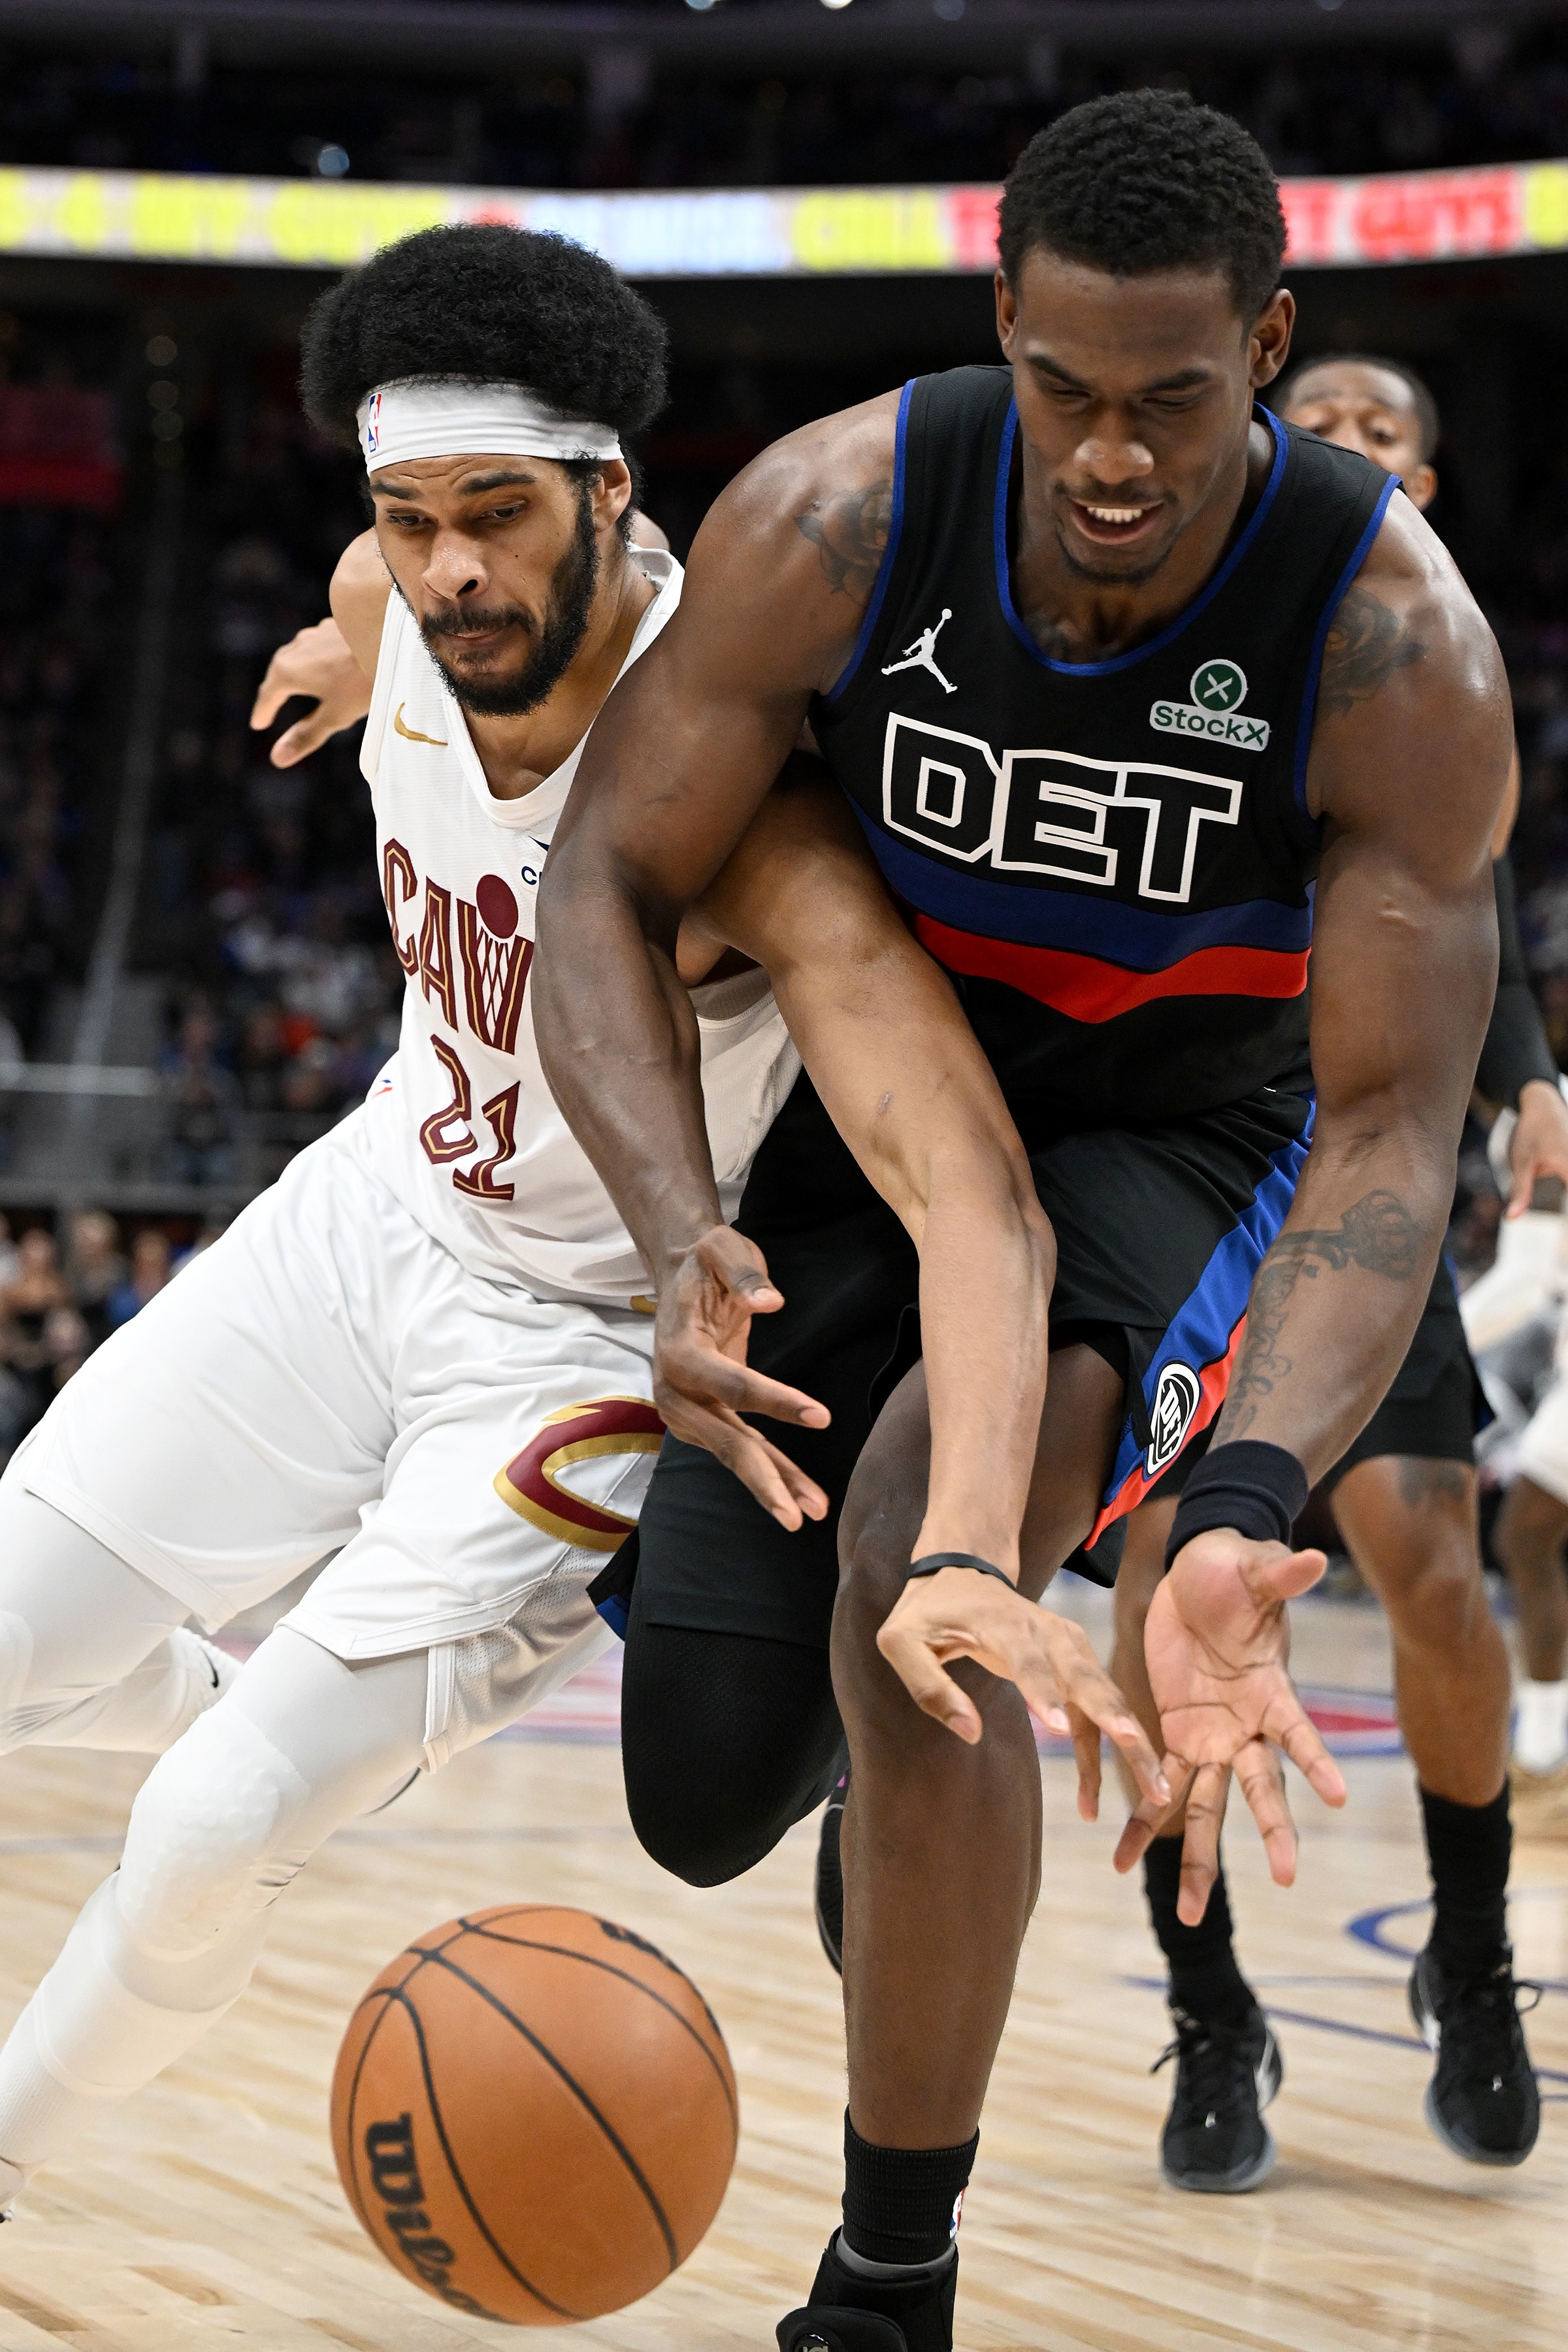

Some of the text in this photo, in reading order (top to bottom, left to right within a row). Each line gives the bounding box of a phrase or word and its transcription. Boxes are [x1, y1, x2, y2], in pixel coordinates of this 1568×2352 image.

[883, 711, 1243, 903] DET
[1154, 705, 1267, 747] StockX
[419, 1033, 521, 1200] 21
